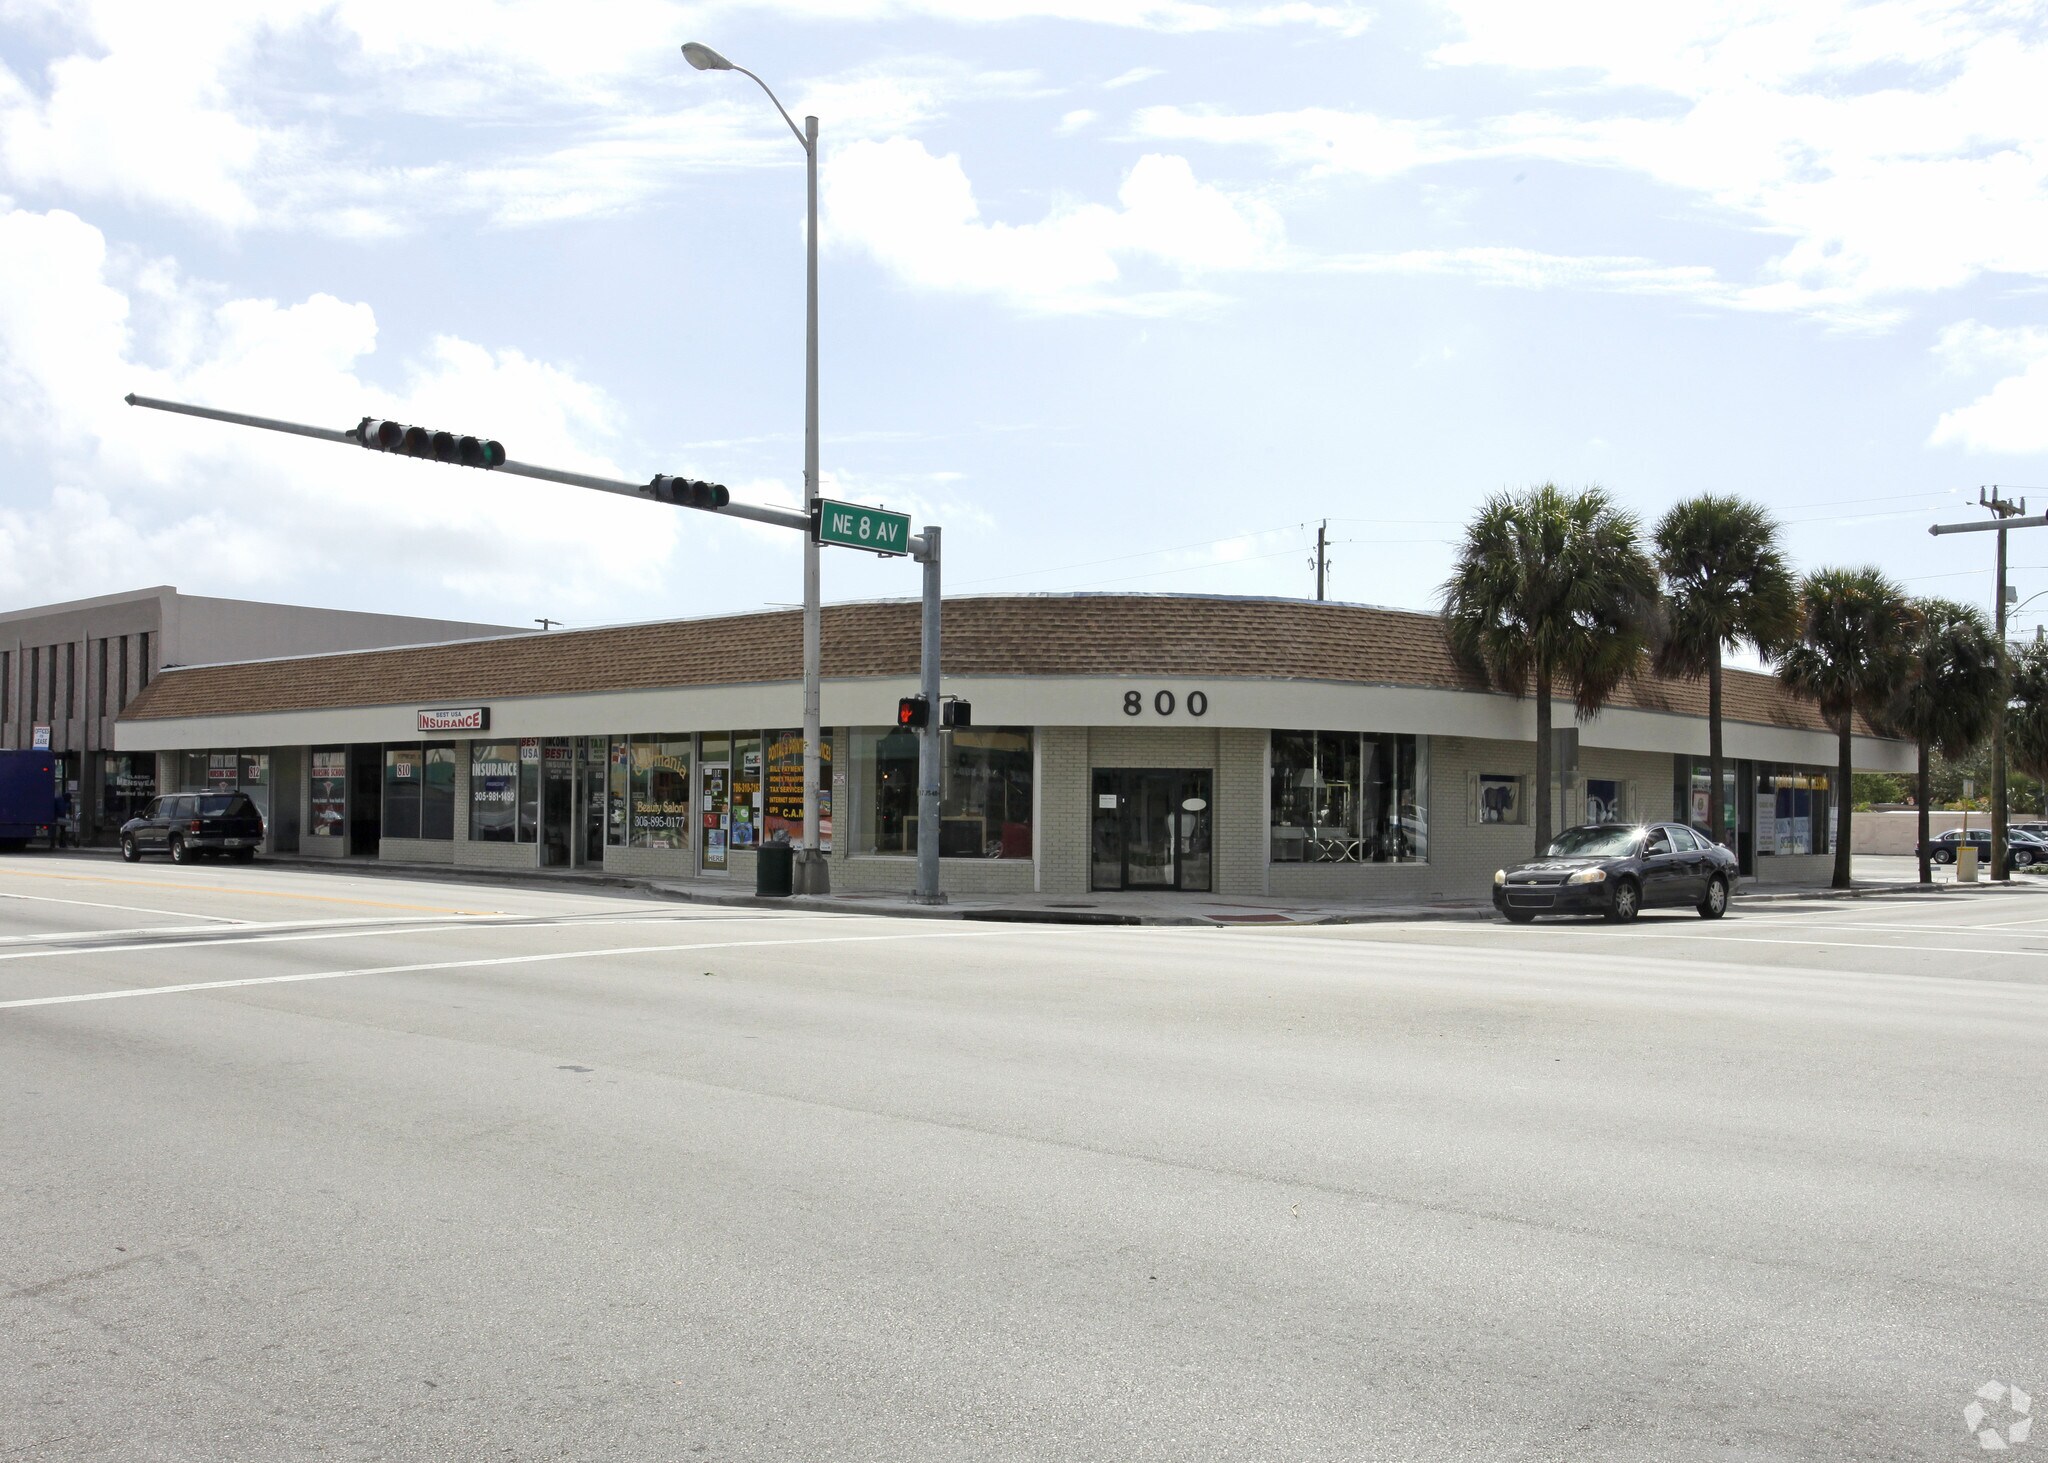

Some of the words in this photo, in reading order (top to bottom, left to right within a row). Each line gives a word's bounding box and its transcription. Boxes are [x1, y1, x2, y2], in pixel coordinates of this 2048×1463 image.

[832, 513, 854, 535] NE
[859, 516, 871, 540] 8
[876, 521, 899, 542] AV
[1123, 690, 1208, 717] 800
[419, 712, 480, 728] INSURANCE
[521, 738, 539, 747] BEST
[545, 737, 570, 747] INCOME
[522, 748, 539, 759] USA
[544, 748, 567, 759] BEST
[248, 766, 260, 778] 812
[397, 763, 410, 777] 810
[472, 763, 517, 777] INSURANCE
[637, 801, 662, 815] Beauty
[662, 801, 684, 813] Salon
[634, 816, 685, 828] 305-895-0177
